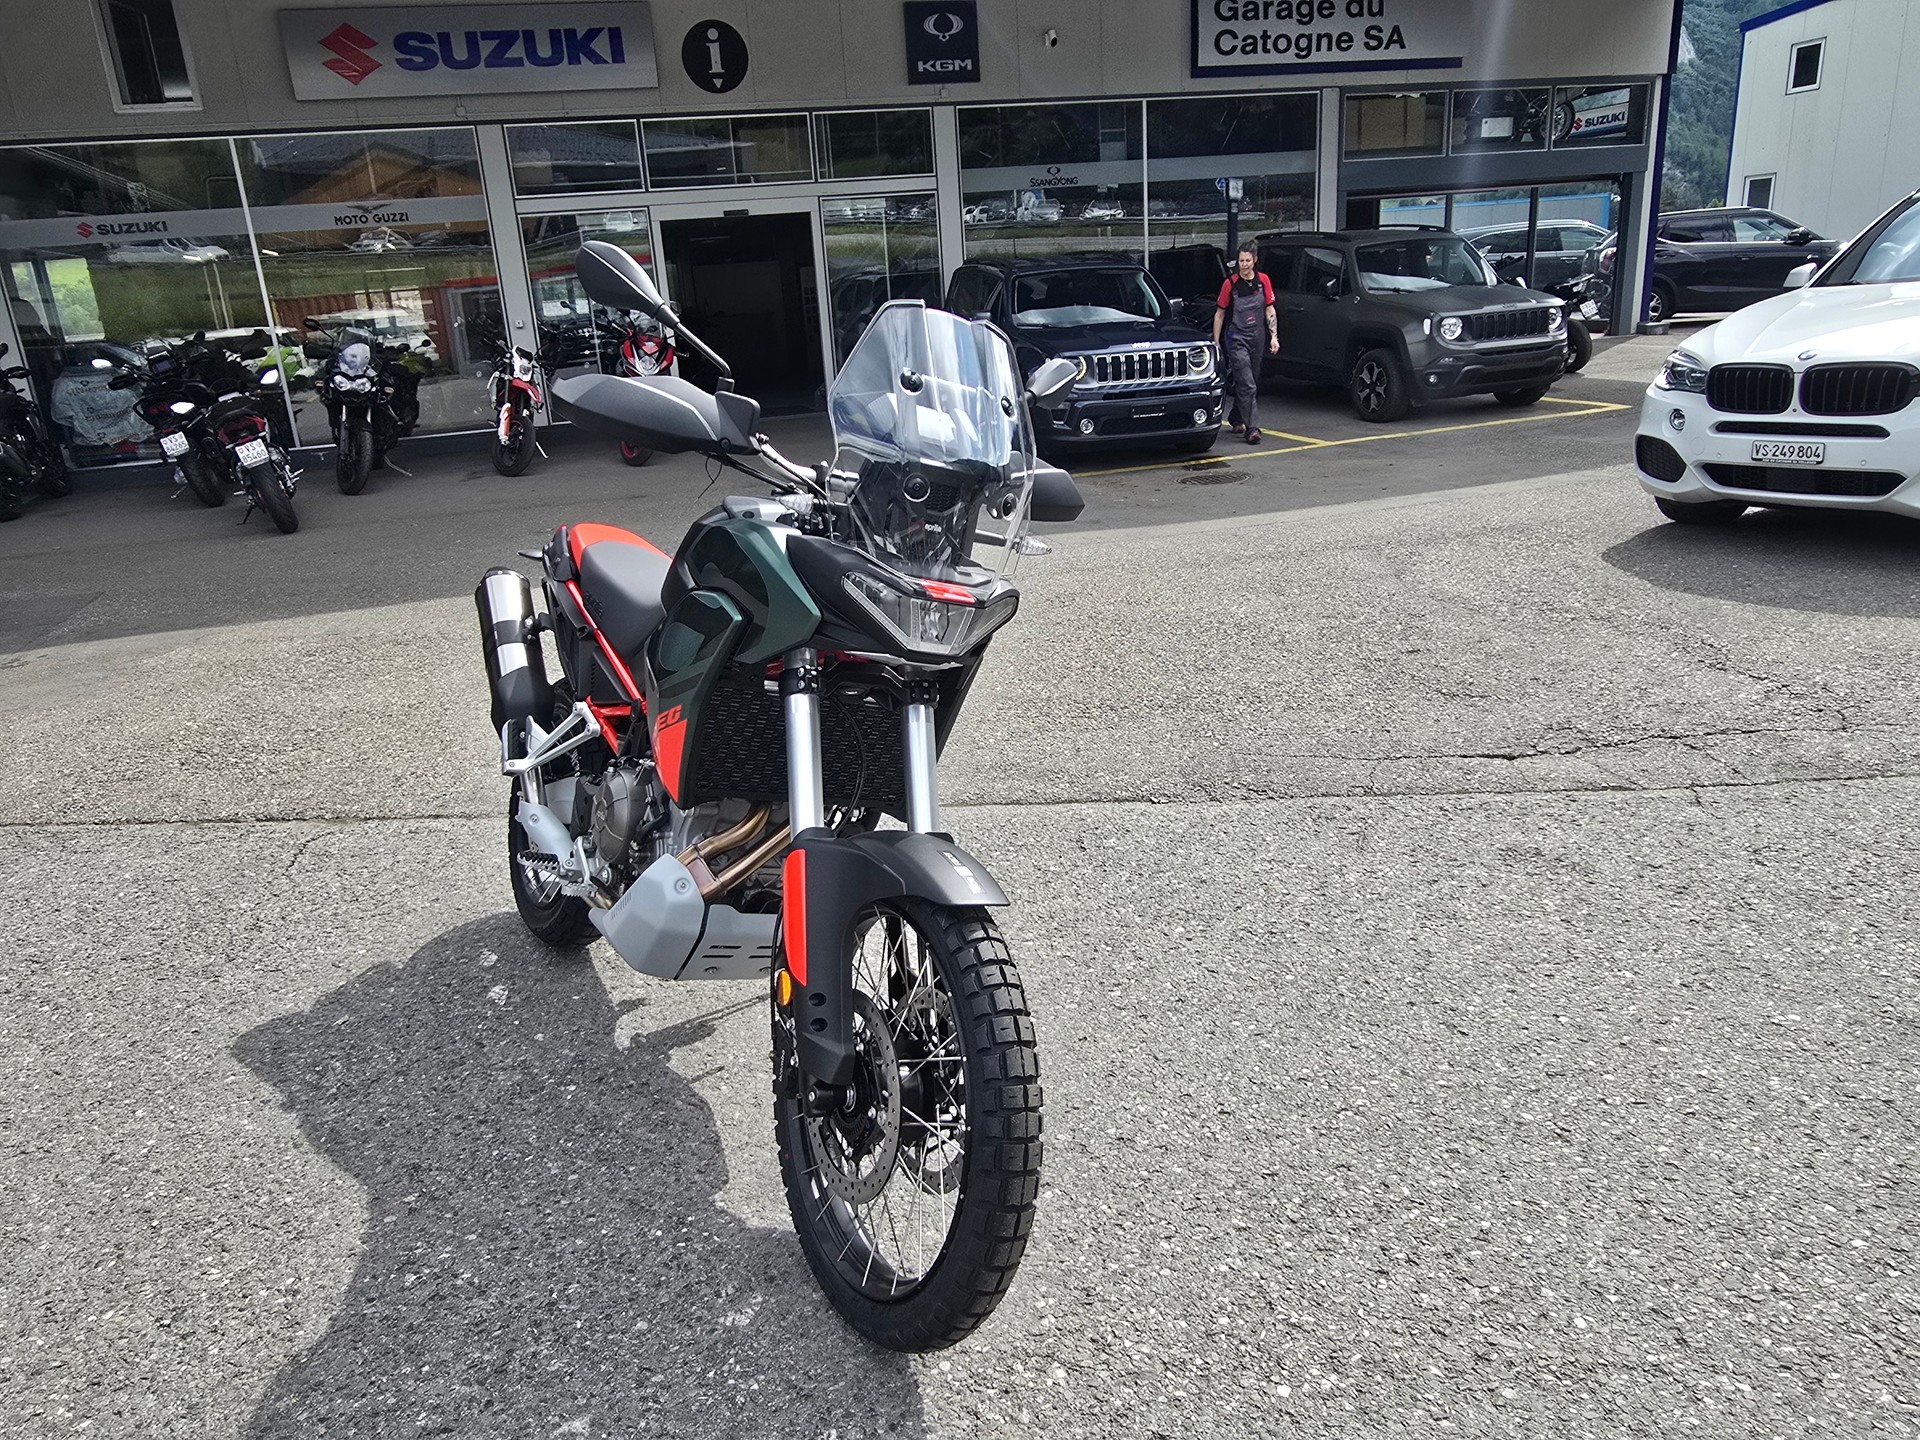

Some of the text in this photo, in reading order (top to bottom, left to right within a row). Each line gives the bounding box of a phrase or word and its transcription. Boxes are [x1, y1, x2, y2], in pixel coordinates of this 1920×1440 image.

[1214, 0, 1384, 25] Garage du
[393, 26, 626, 71] SUZUKI
[1214, 25, 1407, 59] Catogne SA
[917, 58, 972, 72] KGM
[1584, 112, 1625, 128] SUZUKI
[334, 212, 410, 225] MOTO GUZZI
[96, 220, 169, 236] SUZUKI
[242, 449, 267, 464] 85460
[244, 444, 256, 453] VS
